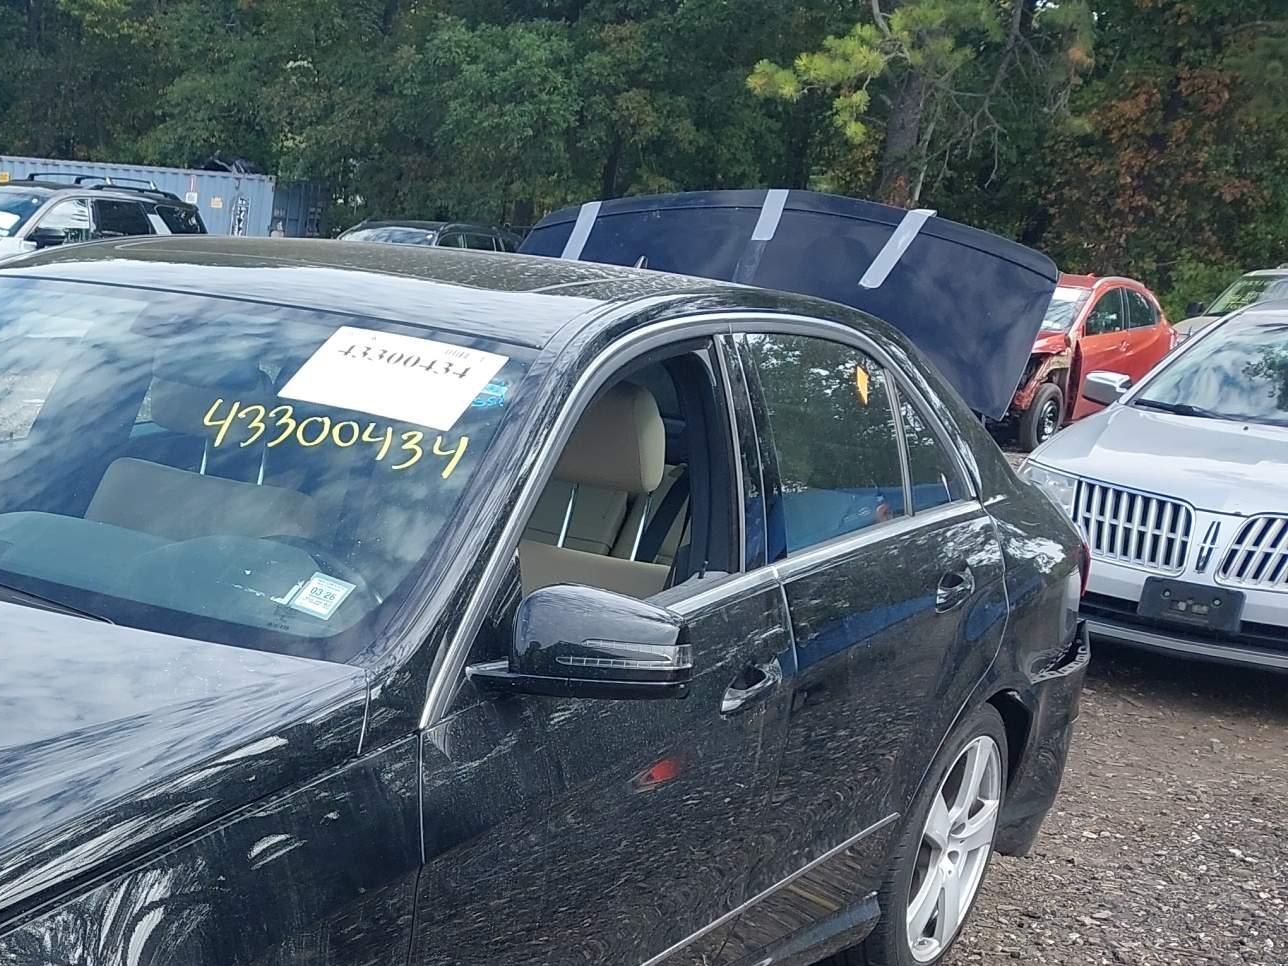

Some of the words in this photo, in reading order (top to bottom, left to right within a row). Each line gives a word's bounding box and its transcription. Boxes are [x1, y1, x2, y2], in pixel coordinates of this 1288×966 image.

[339, 345, 471, 378] 43300434
[203, 399, 469, 479] 43300434
[311, 587, 323, 596] 03
[324, 592, 336, 600] 26
